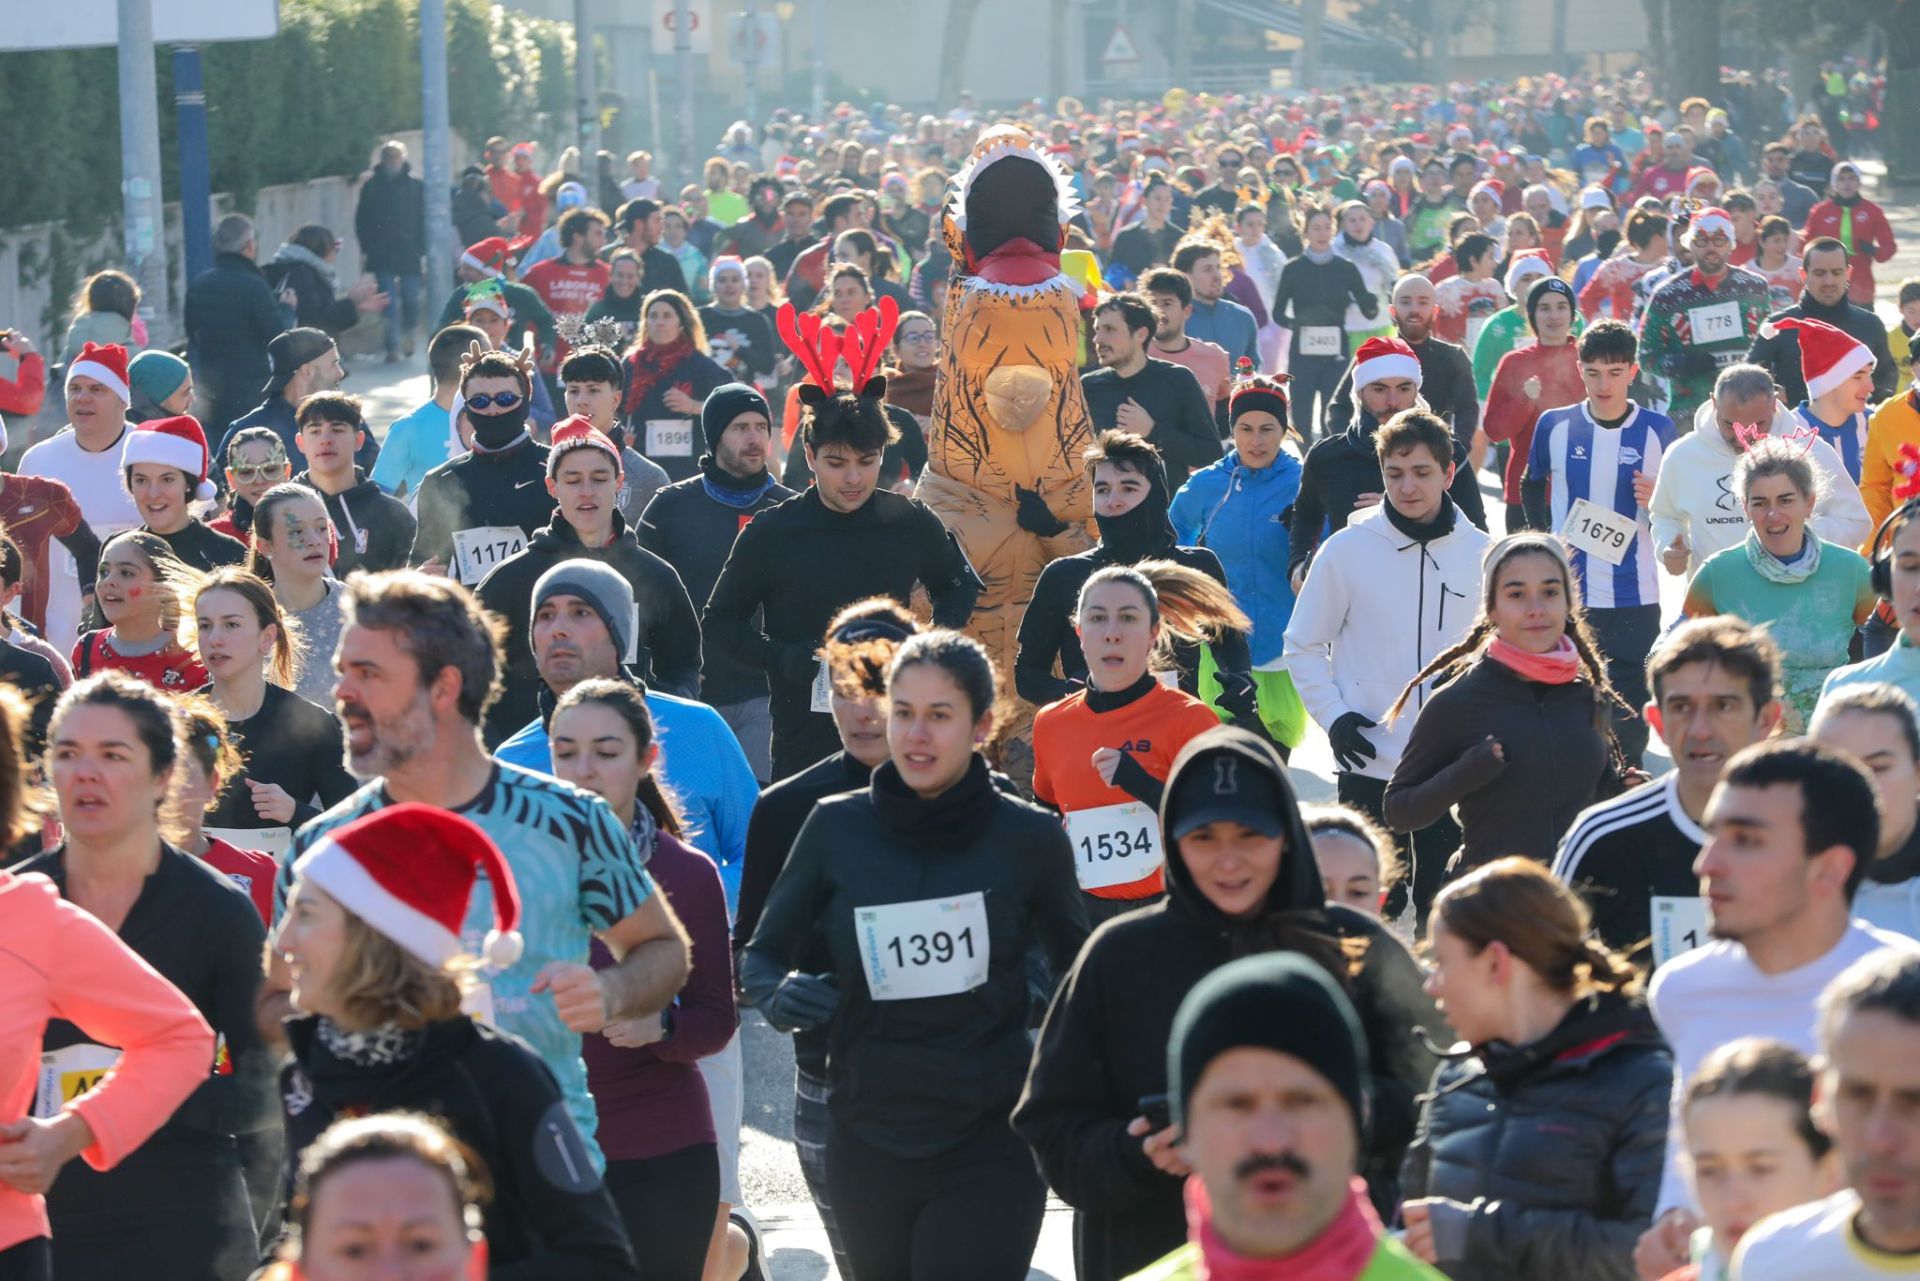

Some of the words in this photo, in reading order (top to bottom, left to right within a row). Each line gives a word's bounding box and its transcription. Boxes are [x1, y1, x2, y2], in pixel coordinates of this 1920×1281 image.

[1705, 315, 1733, 331] 778
[1582, 517, 1625, 548] 1679
[1705, 516, 1744, 524] UNDER
[472, 538, 521, 565] 1174
[1119, 739, 1152, 752] AB
[1080, 826, 1152, 863] 1534
[888, 926, 974, 968] 1391
